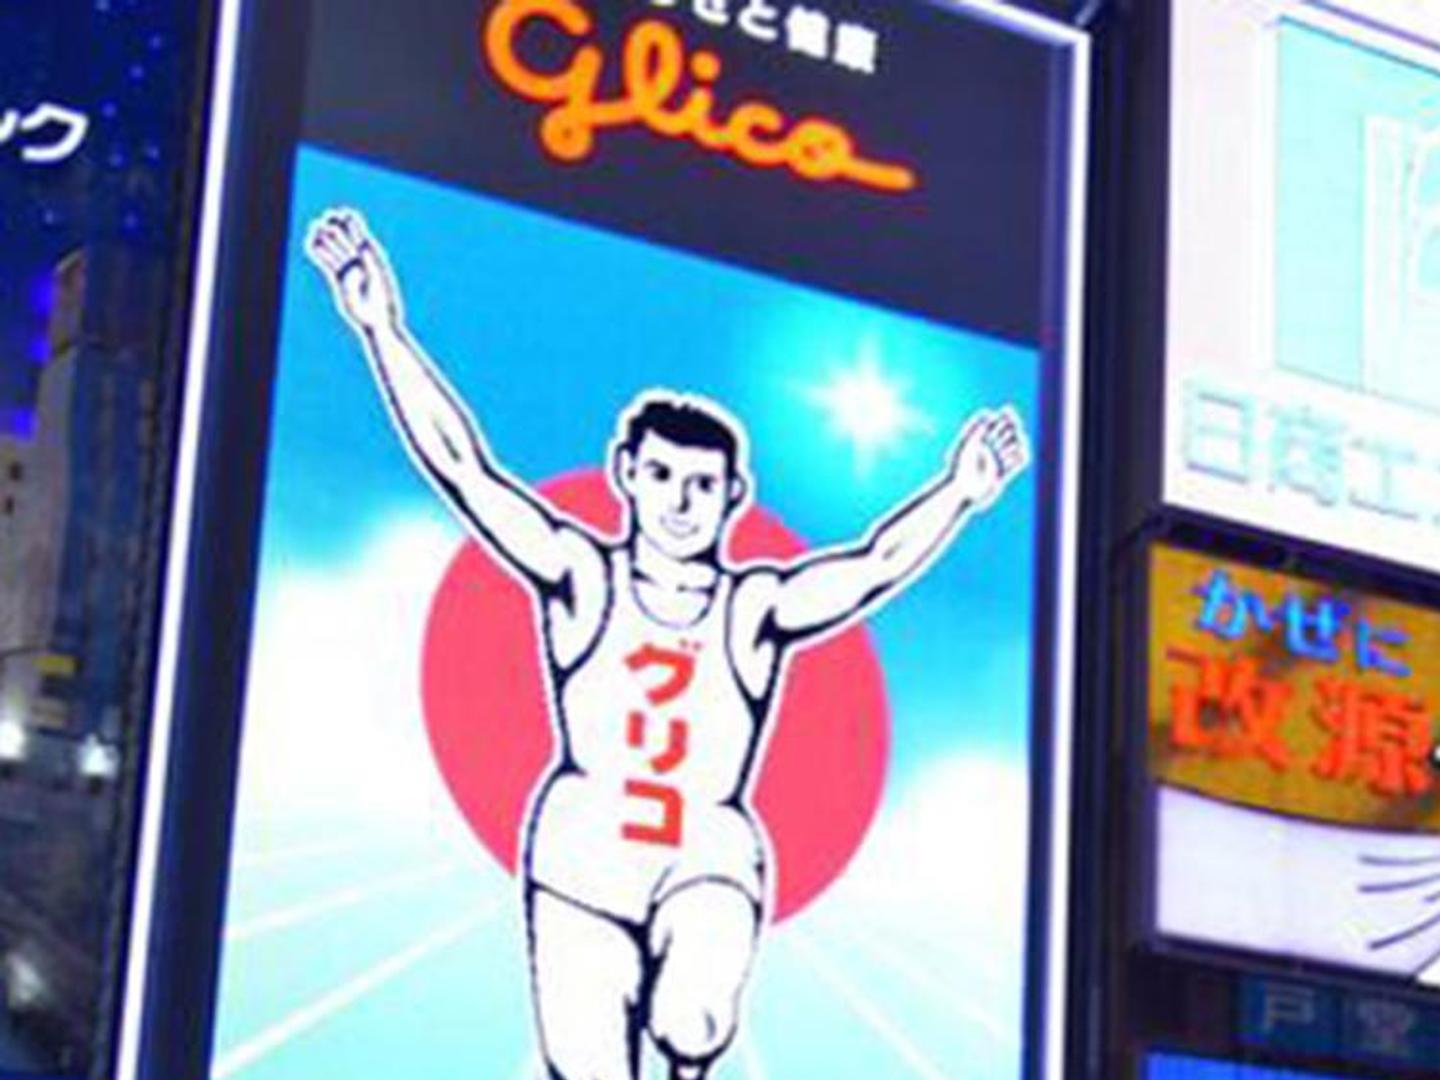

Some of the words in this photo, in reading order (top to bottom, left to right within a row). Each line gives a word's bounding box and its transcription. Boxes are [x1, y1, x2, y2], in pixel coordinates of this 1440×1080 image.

[486, 0, 916, 189] Glico
[1193, 569, 1414, 677] かぜに
[619, 636, 698, 848] グリコ
[1164, 645, 1434, 798] 改源
